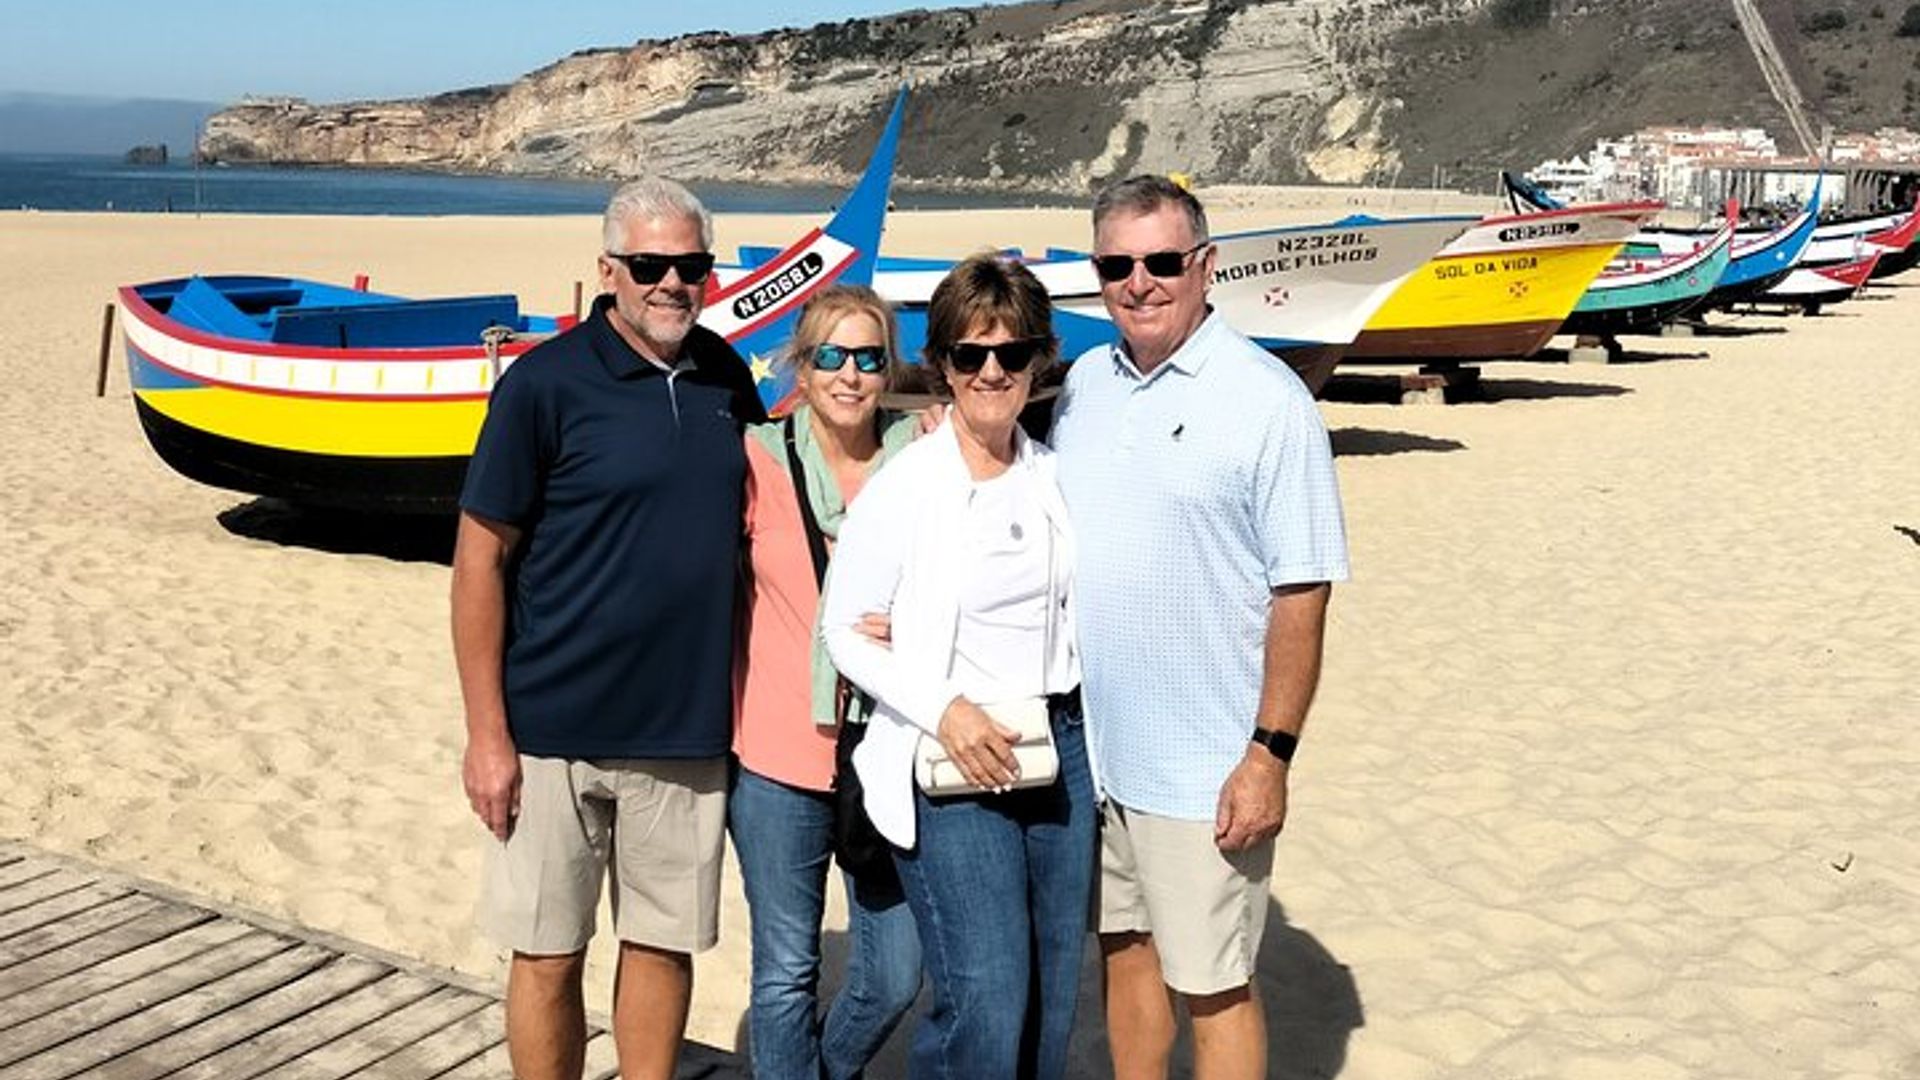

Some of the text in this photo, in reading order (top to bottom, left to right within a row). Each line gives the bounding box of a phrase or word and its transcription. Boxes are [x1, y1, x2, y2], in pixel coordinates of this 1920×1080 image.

[1209, 262, 1258, 284] MOR
[1295, 247, 1379, 269] FILHOS
[1435, 257, 1537, 280] SOL DA VIDA
